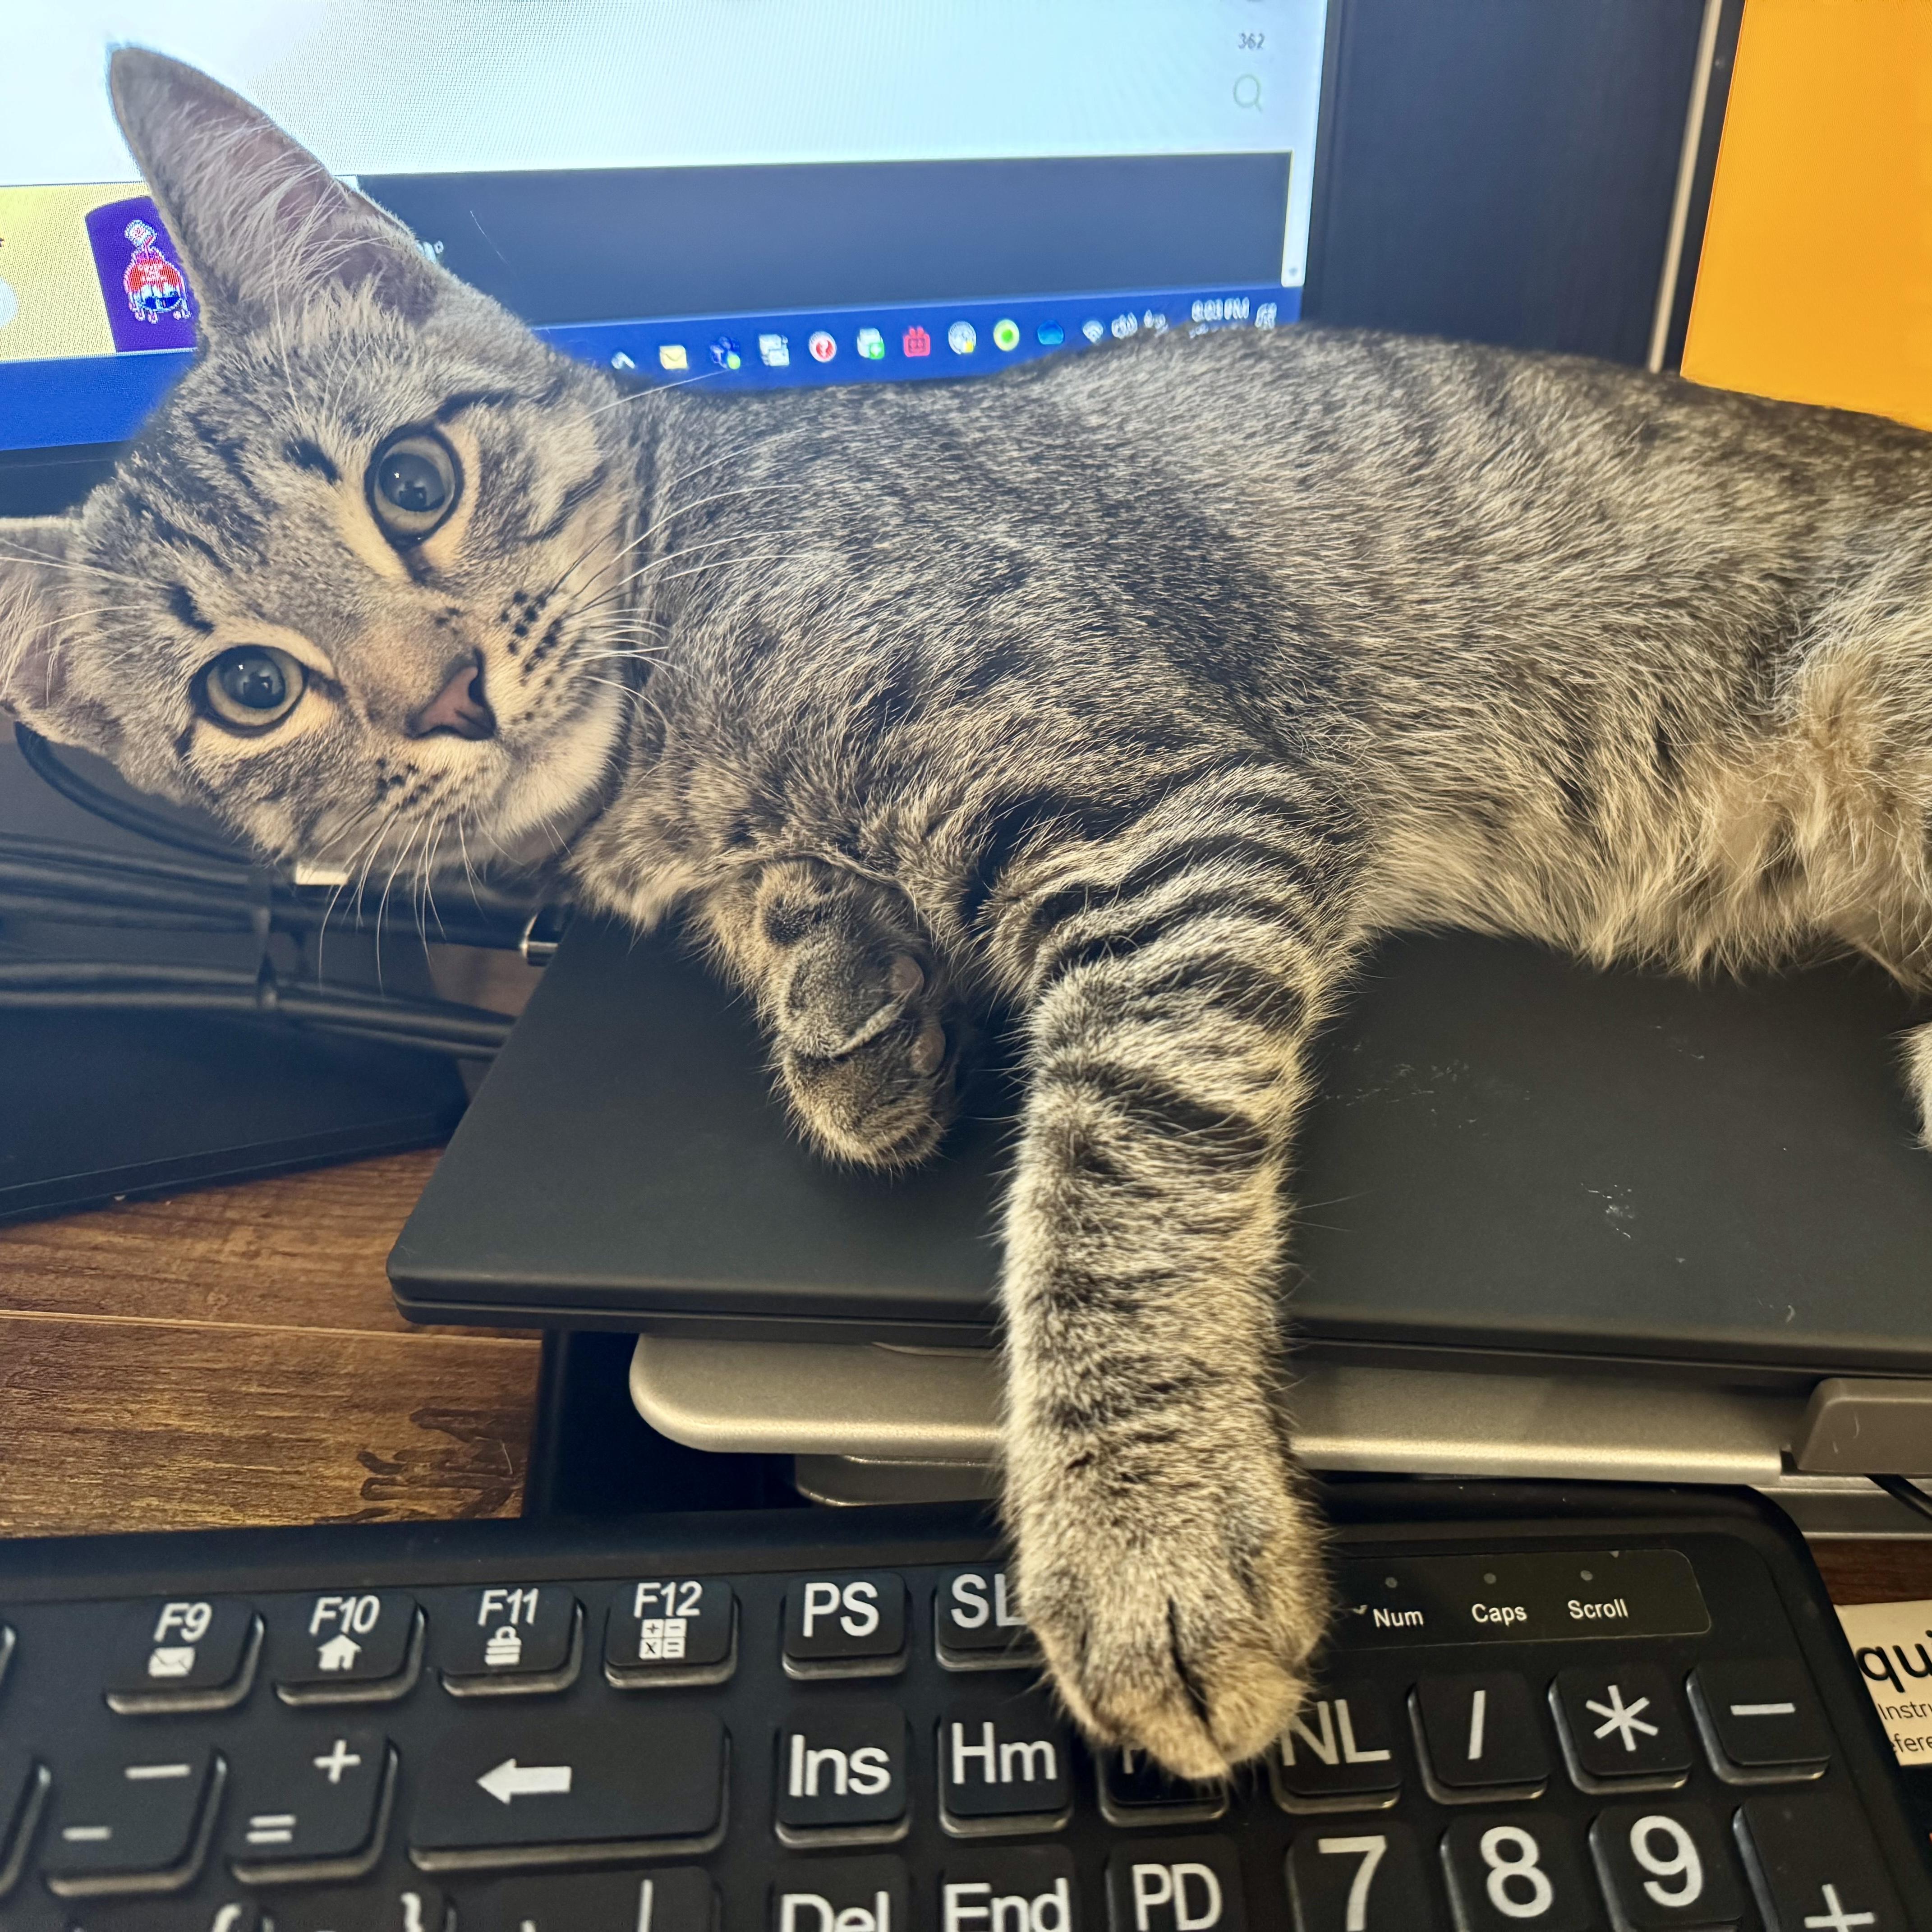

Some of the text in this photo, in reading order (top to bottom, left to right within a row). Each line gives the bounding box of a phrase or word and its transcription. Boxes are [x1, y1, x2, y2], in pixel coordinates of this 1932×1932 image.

[154, 1602, 212, 1642] F9
[309, 1595, 380, 1636] F10
[478, 1588, 538, 1626] F11
[634, 1581, 703, 1618] F12
[803, 1581, 879, 1638] PS
[950, 1573, 1029, 1628] SL
[1373, 1599, 1628, 1627] Num Caps Scroll
[1856, 1630, 1932, 1693] qu
[1281, 1699, 1390, 1766] NL
[1877, 1702, 1932, 1720] Instr
[789, 1734, 891, 1797] Ins
[952, 1721, 1057, 1784] Hm
[1318, 1835, 1387, 1932] 7
[1480, 1826, 1553, 1918] 8
[1630, 1815, 1702, 1907] 9
[781, 1891, 889, 1932] Del
[944, 1877, 1072, 1932] End
[1132, 1863, 1222, 1932] PD
